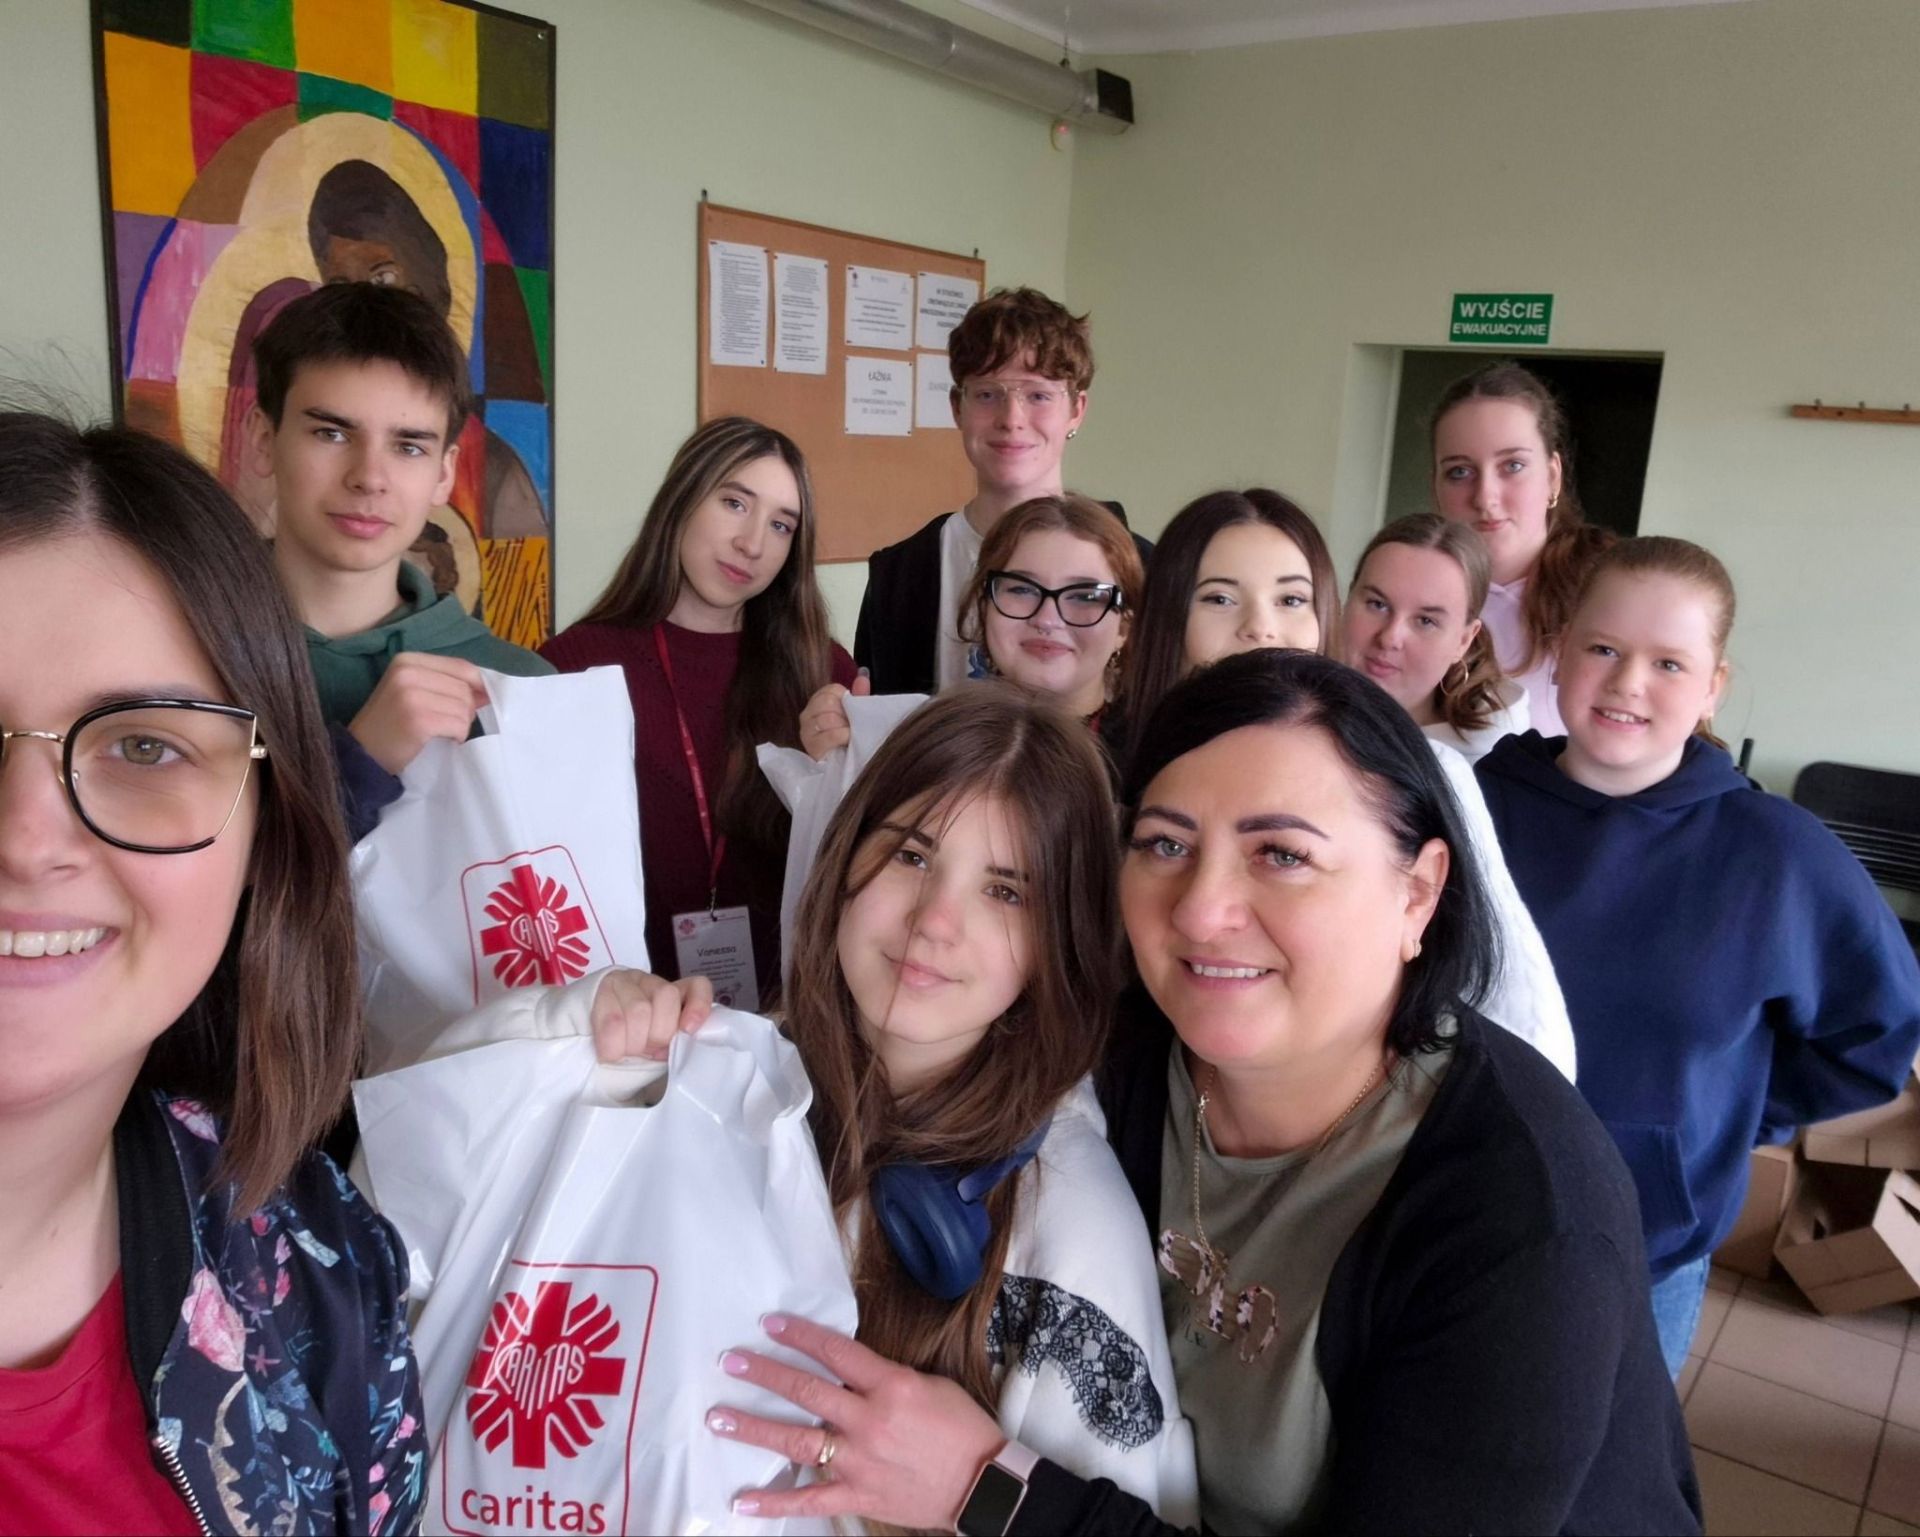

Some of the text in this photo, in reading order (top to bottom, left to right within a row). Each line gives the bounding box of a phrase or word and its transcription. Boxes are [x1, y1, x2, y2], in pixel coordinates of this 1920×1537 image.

[1460, 299, 1545, 319] WYJŚCIE
[1452, 322, 1547, 337] EWAKUACYJNE
[493, 1341, 586, 1420] CARITAS
[460, 1484, 606, 1535] caritas
